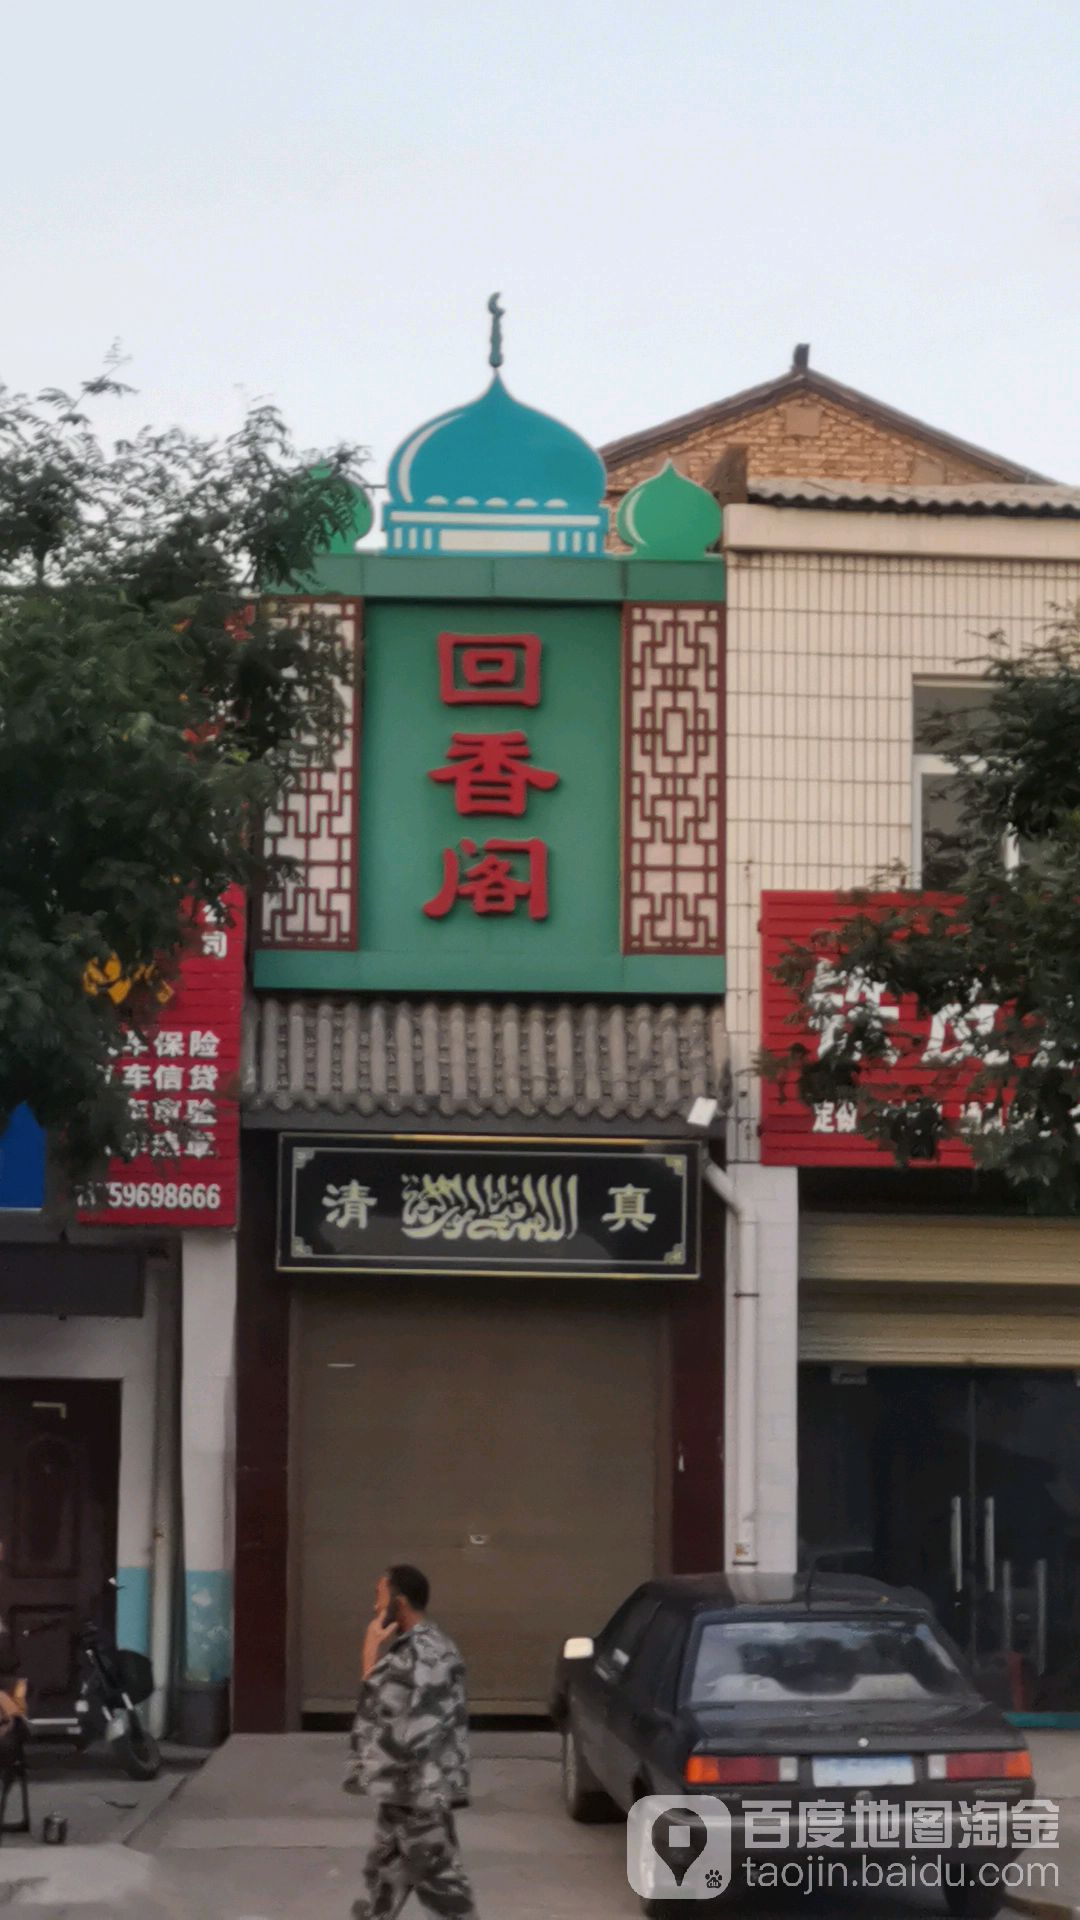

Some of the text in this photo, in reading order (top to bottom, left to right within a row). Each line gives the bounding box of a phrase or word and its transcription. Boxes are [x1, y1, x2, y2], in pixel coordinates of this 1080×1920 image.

[422, 632, 559, 921] 回香阁
[97, 1063, 218, 1092] 车信贷
[322, 1179, 378, 1229] 清
[602, 1184, 657, 1232] 真
